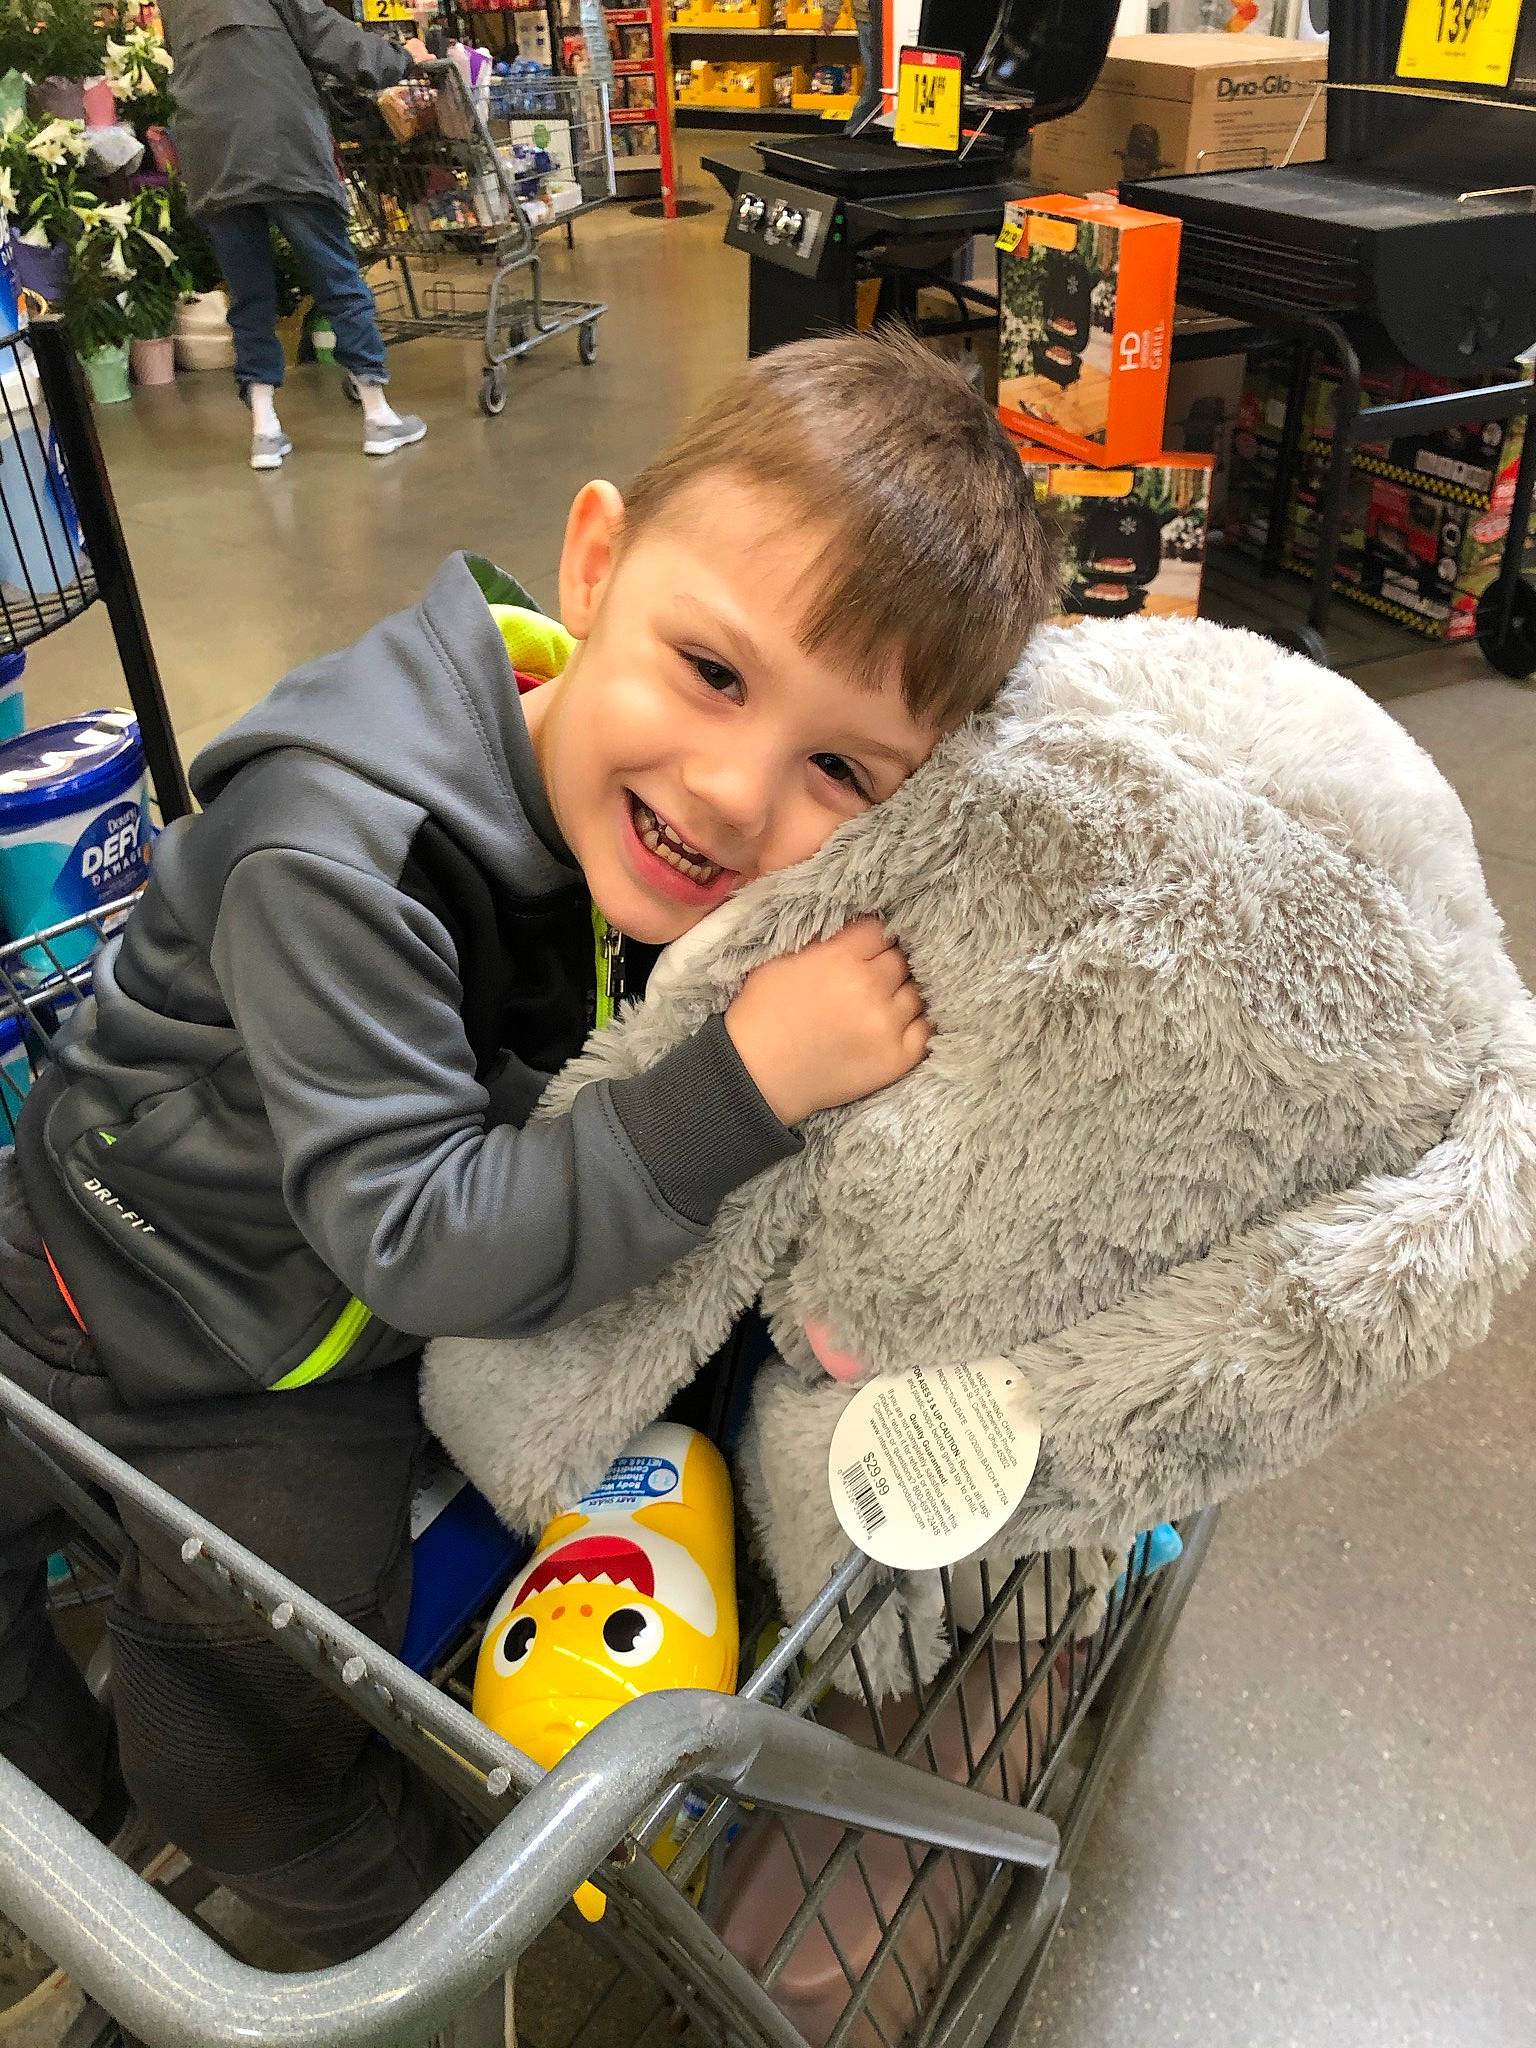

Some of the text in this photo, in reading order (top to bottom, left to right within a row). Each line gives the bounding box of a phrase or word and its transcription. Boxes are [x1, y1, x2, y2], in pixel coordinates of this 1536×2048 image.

[1119, 331, 1141, 372] HD
[81, 816, 141, 879] DEFY
[84, 1177, 156, 1233] DRI-FIT
[911, 1363, 922, 1379] FOR
[906, 1377, 917, 1390] and
[917, 1376, 931, 1398] AGES
[910, 1388, 925, 1410] plastic
[929, 1402, 936, 1410] &
[921, 1408, 934, 1428] loops
[932, 1408, 942, 1420] UP
[984, 1388, 992, 1397] IN
[1001, 1420, 1015, 1443] CHINA
[890, 1418, 903, 1439] return
[931, 1426, 945, 1451] before
[935, 1368, 958, 1408] PRODUCTION
[980, 1457, 997, 1483] BATCH
[996, 1487, 1008, 1505] 2704
[899, 1437, 907, 1445] it
[902, 1443, 911, 1455] for
[909, 1413, 948, 1487] Quality Guaranteed:
[938, 1421, 960, 1460] CAUTION:
[987, 1432, 998, 1449] Ohio
[996, 1448, 1010, 1469] 45202
[887, 1393, 898, 1407] you
[894, 1406, 903, 1418] are
[900, 1417, 910, 1430] not
[905, 1429, 927, 1467] completely
[924, 1467, 944, 1498] satisfied
[940, 1497, 951, 1514] with
[947, 1513, 958, 1529] this
[940, 1451, 956, 1474] giving
[999, 1437, 1017, 1467] Products
[862, 1451, 889, 1496] $29.99
[872, 1402, 940, 1536] Comments or questions? 800-697-2448
[907, 1455, 924, 1479] refund
[957, 1458, 976, 1490] Remove
[616, 1481, 641, 1490] Body
[919, 1479, 927, 1488] or
[953, 1472, 962, 1485] toy
[959, 1484, 967, 1494] to
[973, 1489, 983, 1501] all
[978, 1499, 990, 1518] tags
[865, 1533, 874, 1541] 4
